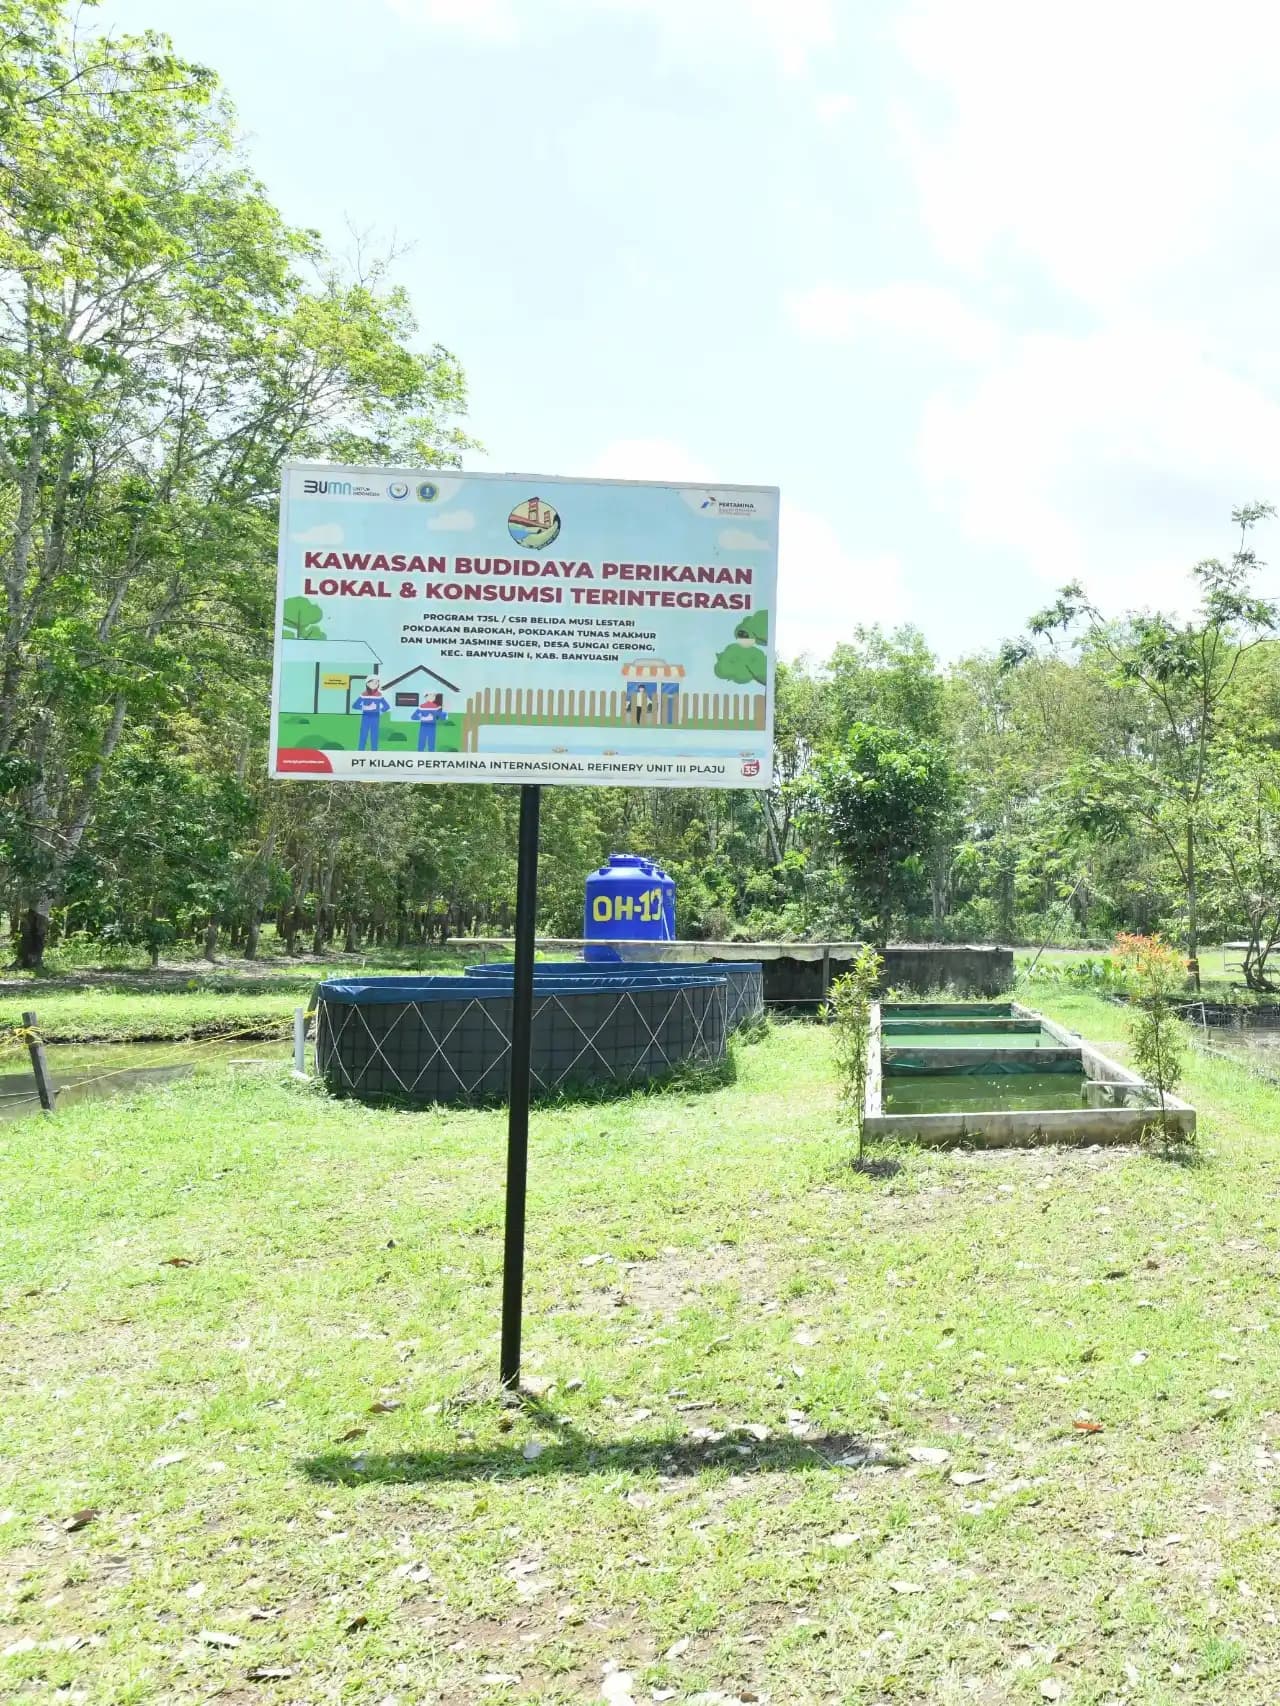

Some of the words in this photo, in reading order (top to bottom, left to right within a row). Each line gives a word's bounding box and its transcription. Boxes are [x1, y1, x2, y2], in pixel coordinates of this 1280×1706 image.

[305, 551, 446, 573] KAWASAN
[455, 557, 594, 579] BUDIDAYA
[602, 562, 753, 584] PERIKANAN
[304, 578, 392, 598] LOKAL
[400, 582, 417, 598] &
[426, 582, 562, 603] KONSUMSI
[570, 588, 751, 610] TERINTEGRASI
[423, 613, 474, 622] PROGRAM
[477, 615, 499, 623] TJSL
[530, 617, 566, 625] BELIDA
[569, 618, 593, 626] MUSI
[596, 619, 635, 627] LESTARI
[402, 624, 461, 633] POKDAKAN
[463, 626, 516, 636] BAROKAH,
[518, 628, 575, 637] POKDAKAN
[577, 630, 610, 638] TUNAS
[612, 631, 657, 640] MAKMUR
[400, 636, 423, 644] DAN
[425, 637, 457, 645] UMKM
[460, 638, 503, 646] JASMINE
[505, 639, 541, 648] SUGER,
[572, 642, 609, 650] SUNGAI
[612, 643, 656, 652] GERONG,
[440, 649, 463, 657] KEC.
[466, 650, 524, 659] BANYUASIN
[535, 652, 558, 660] KAB.
[561, 653, 619, 661] BANYUASIN
[351, 759, 366, 767] PT
[369, 759, 414, 768] KILANG
[417, 760, 486, 769] PERTAMINA
[490, 761, 584, 771] INTERNASIONAL
[587, 763, 643, 772] REFINERY
[646, 764, 672, 773] UNIT
[676, 764, 687, 774] III
[690, 765, 726, 774] PLAJU
[743, 764, 758, 776] 35
